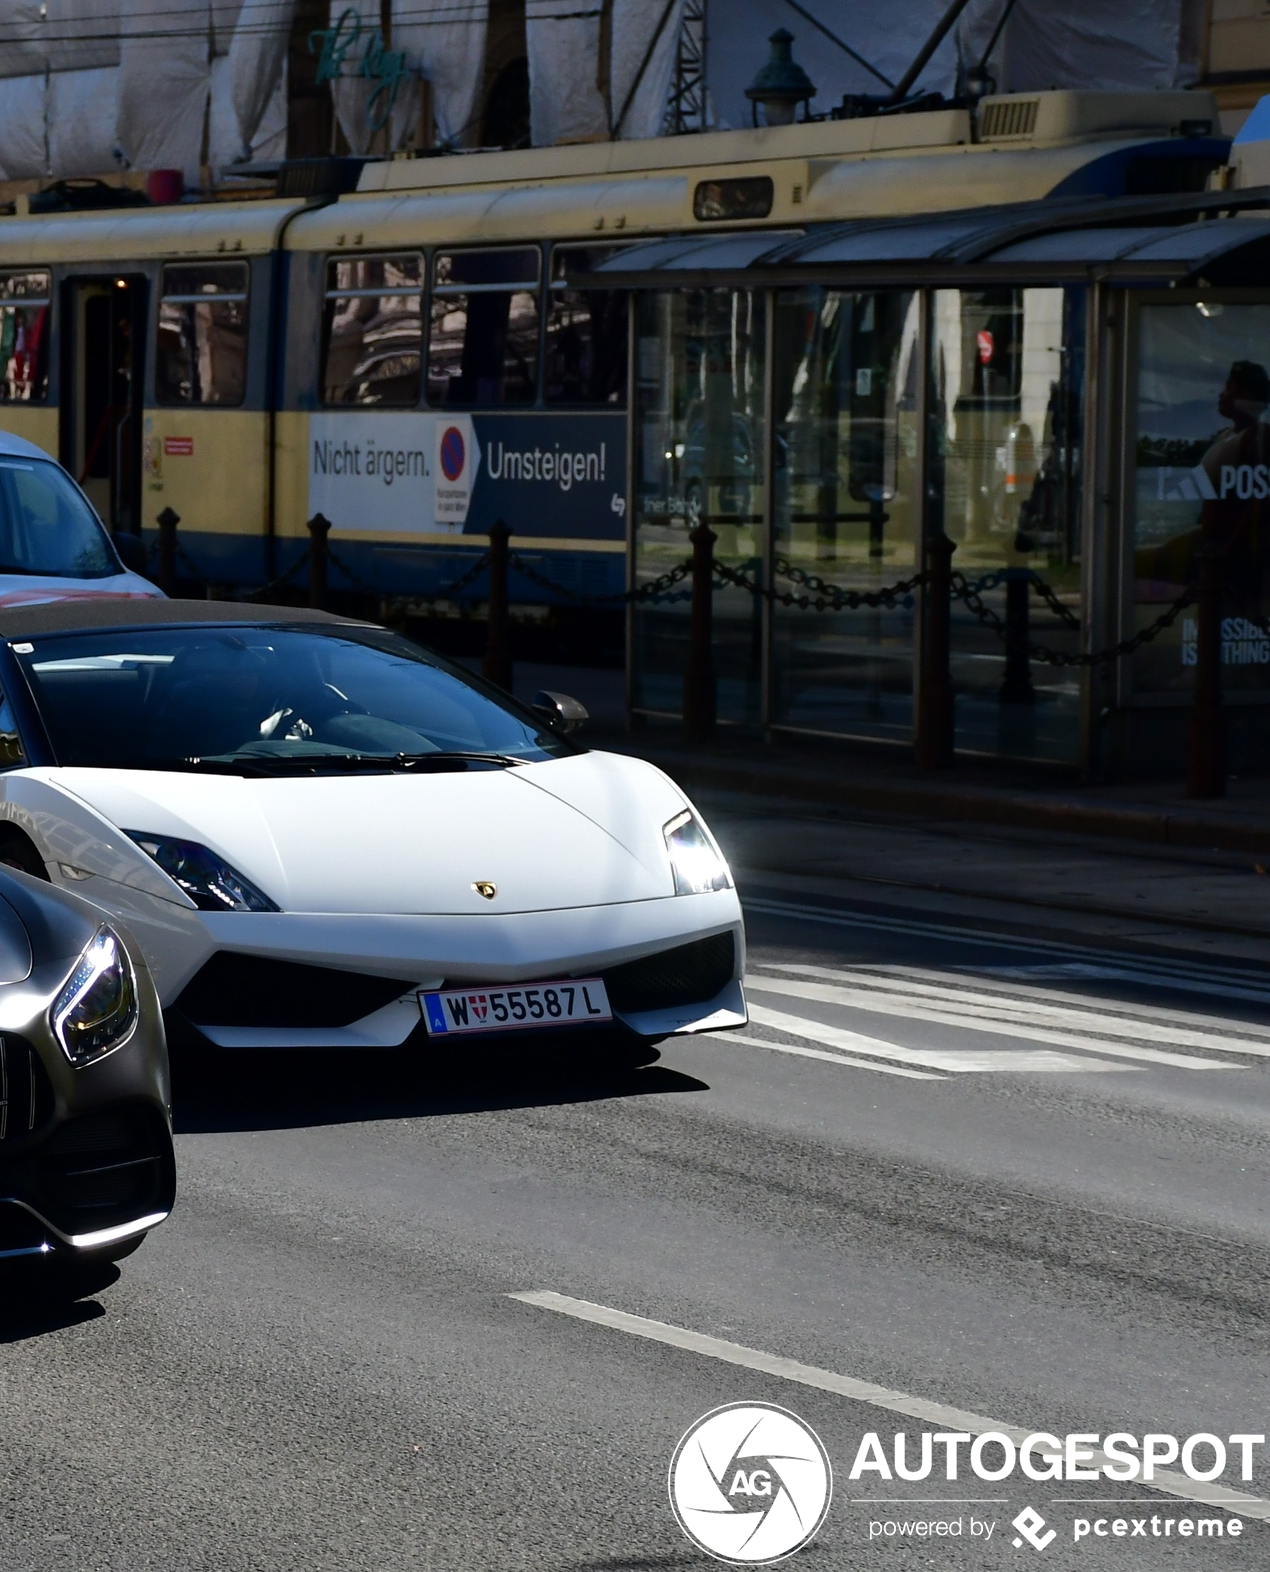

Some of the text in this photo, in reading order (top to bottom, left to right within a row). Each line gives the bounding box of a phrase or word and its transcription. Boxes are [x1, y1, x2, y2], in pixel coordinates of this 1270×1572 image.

[313, 440, 430, 485] Nicht ärgern.
[487, 441, 606, 492] Umsteigen!
[434, 1018, 443, 1028] A
[446, 996, 470, 1027] W
